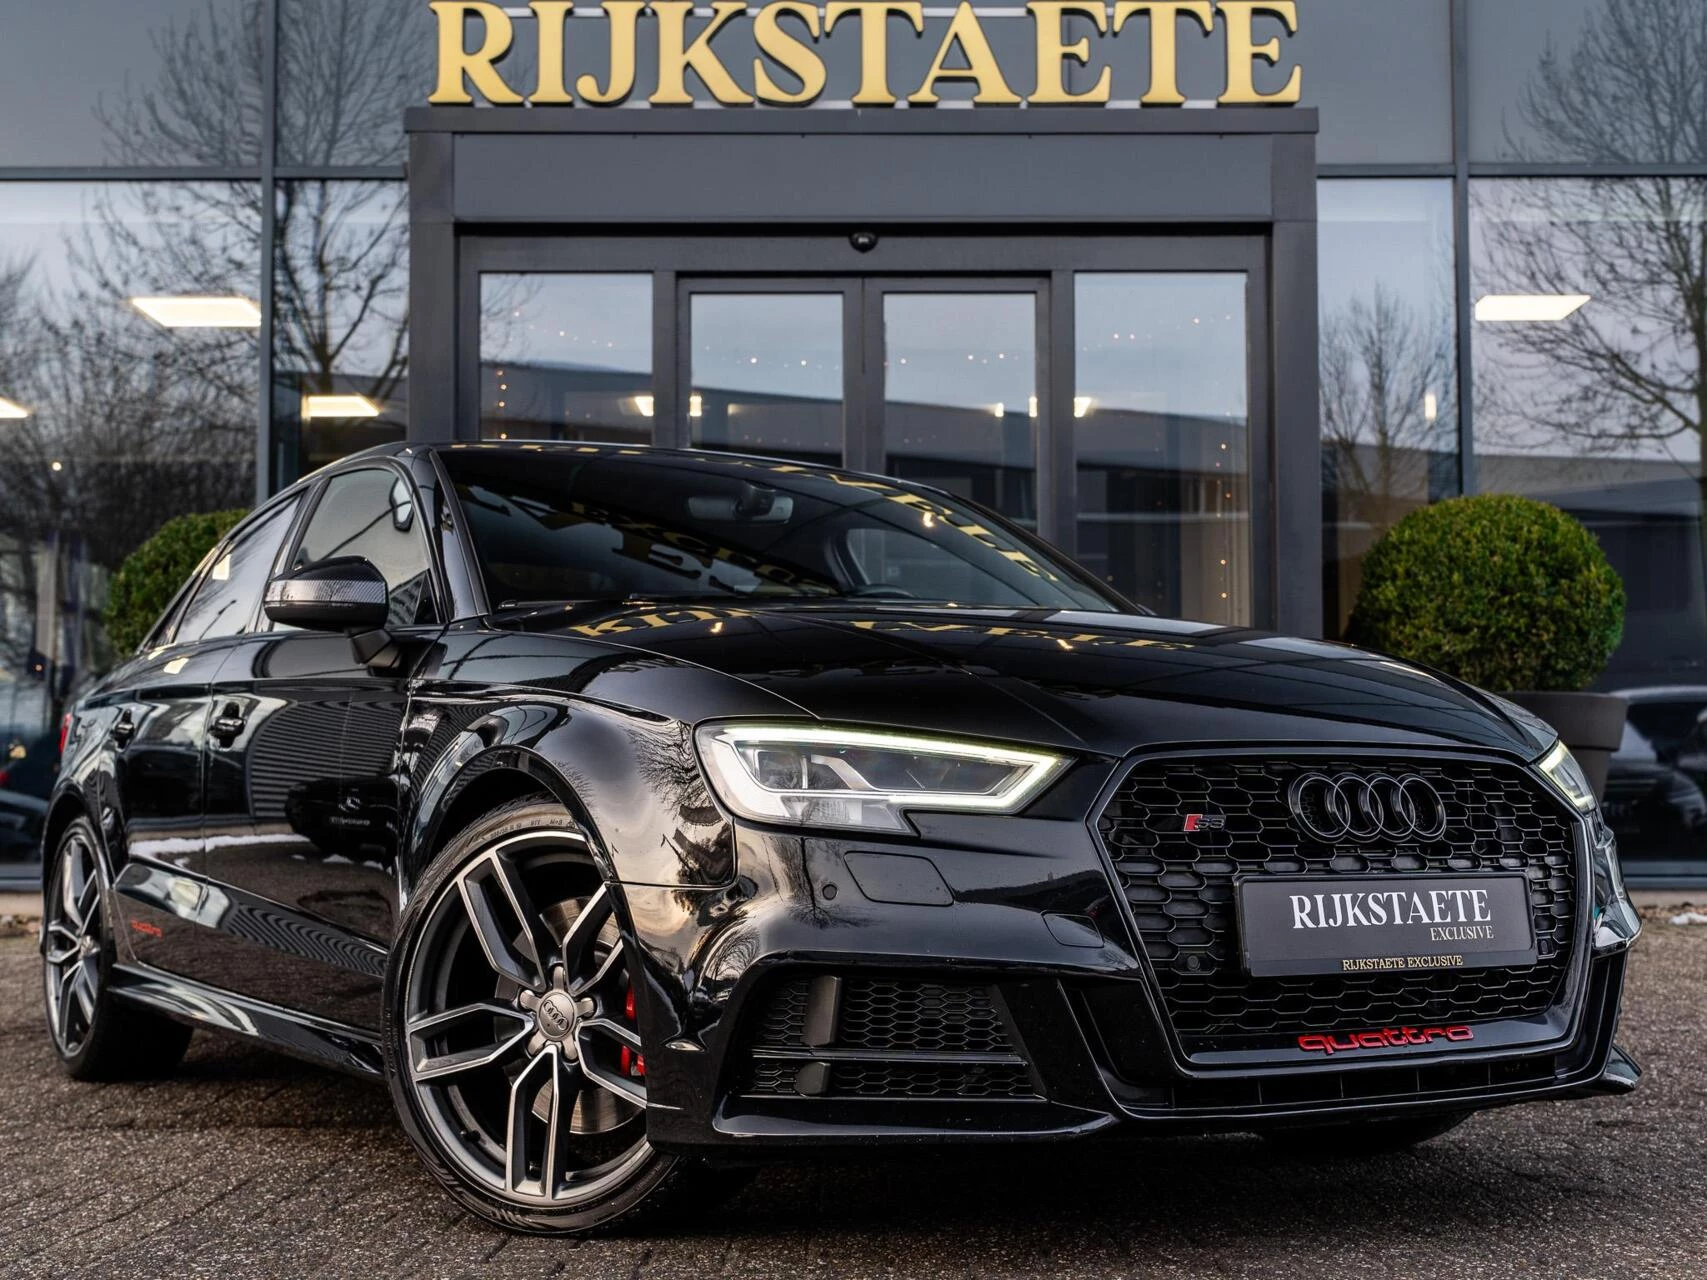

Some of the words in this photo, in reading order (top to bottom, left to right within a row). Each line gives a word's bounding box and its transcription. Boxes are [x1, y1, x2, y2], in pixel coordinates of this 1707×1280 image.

[428, 1, 1303, 105] RIJKSTAETE
[1289, 890, 1491, 929] RIJKSTAETE
[1430, 926, 1494, 941] EXCLUSIVE
[1342, 957, 1405, 971] RIJKSTAETE
[1407, 955, 1463, 967] EXCLUSIVE
[1298, 1026, 1474, 1055] quattro
